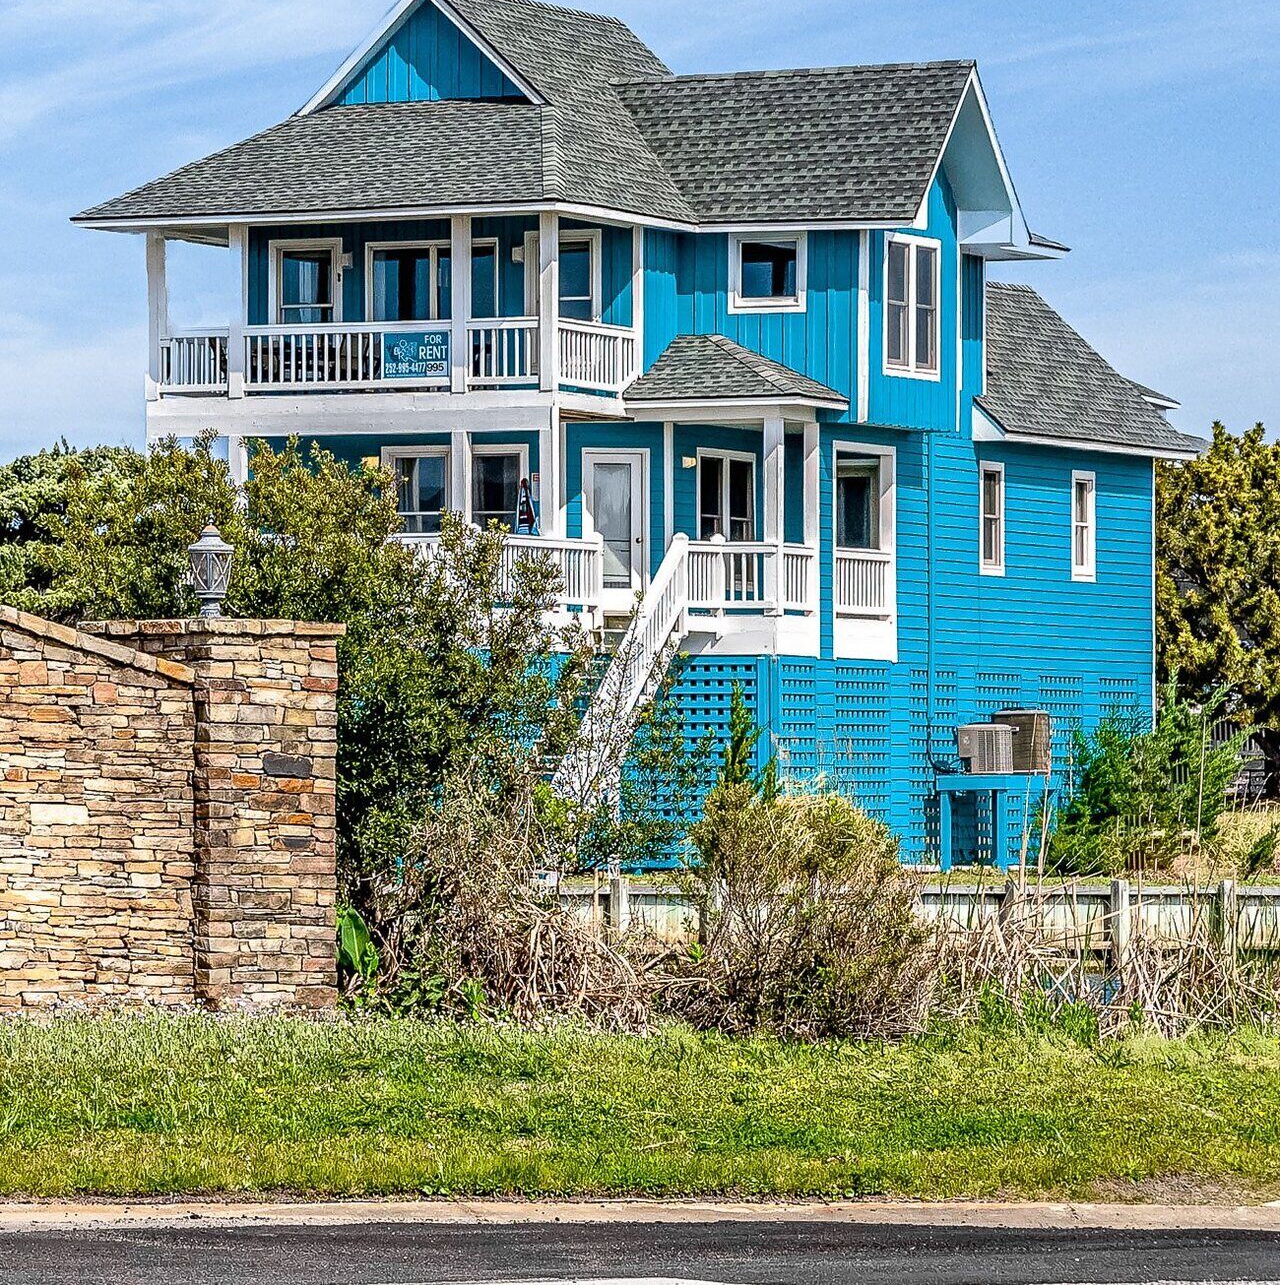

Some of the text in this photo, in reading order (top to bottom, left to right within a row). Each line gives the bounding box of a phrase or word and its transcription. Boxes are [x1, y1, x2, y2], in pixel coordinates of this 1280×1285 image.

[424, 334, 442, 344] FOR
[419, 345, 447, 360] RENT
[426, 362, 445, 372] 995
